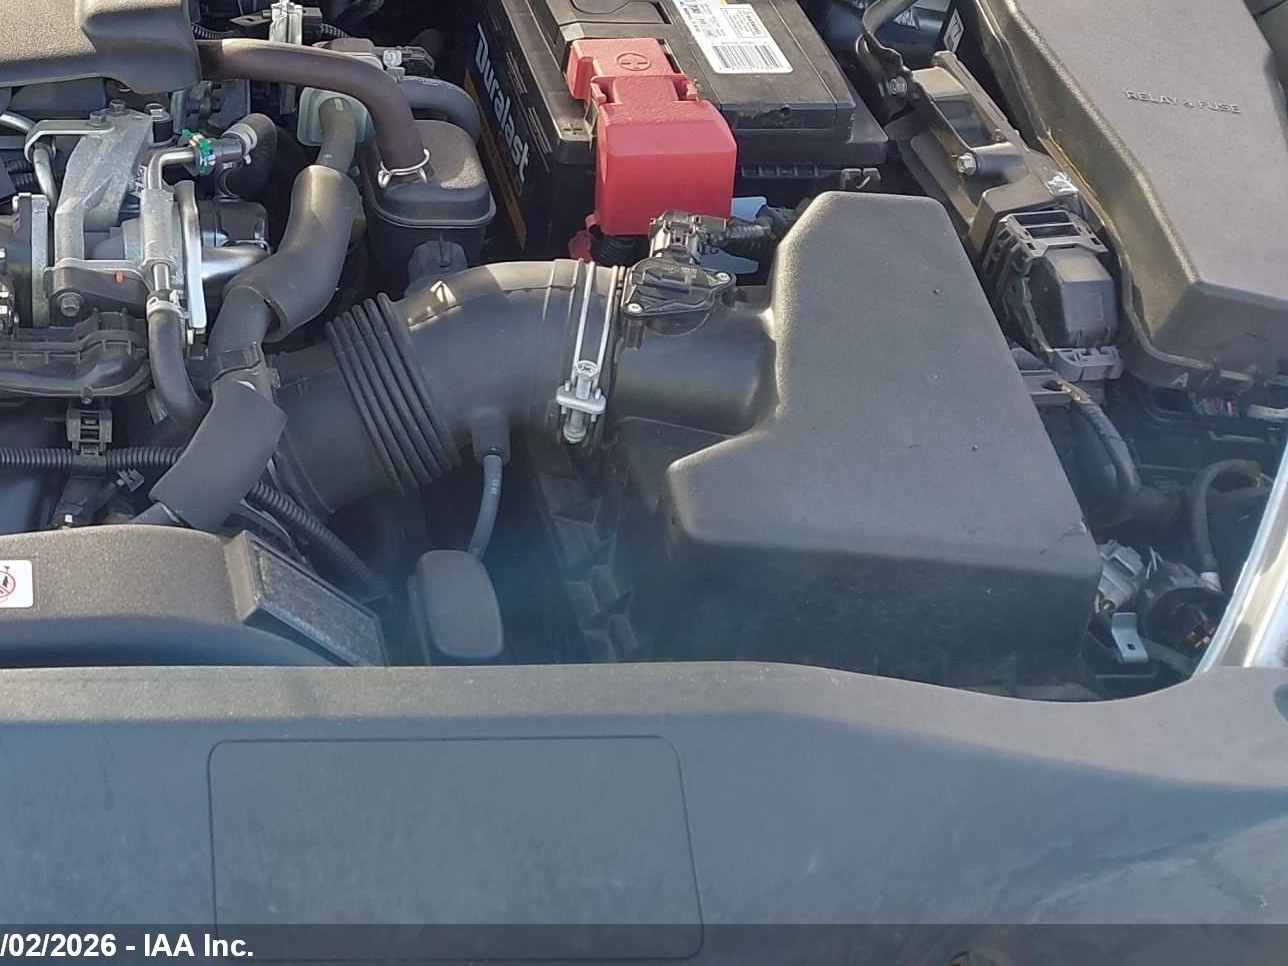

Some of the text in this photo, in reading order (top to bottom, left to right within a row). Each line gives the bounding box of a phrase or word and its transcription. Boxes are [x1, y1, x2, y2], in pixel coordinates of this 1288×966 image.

[475, 22, 530, 184] Duralast
[1126, 90, 1177, 106] RELAY
[1198, 100, 1241, 114] FUSE
